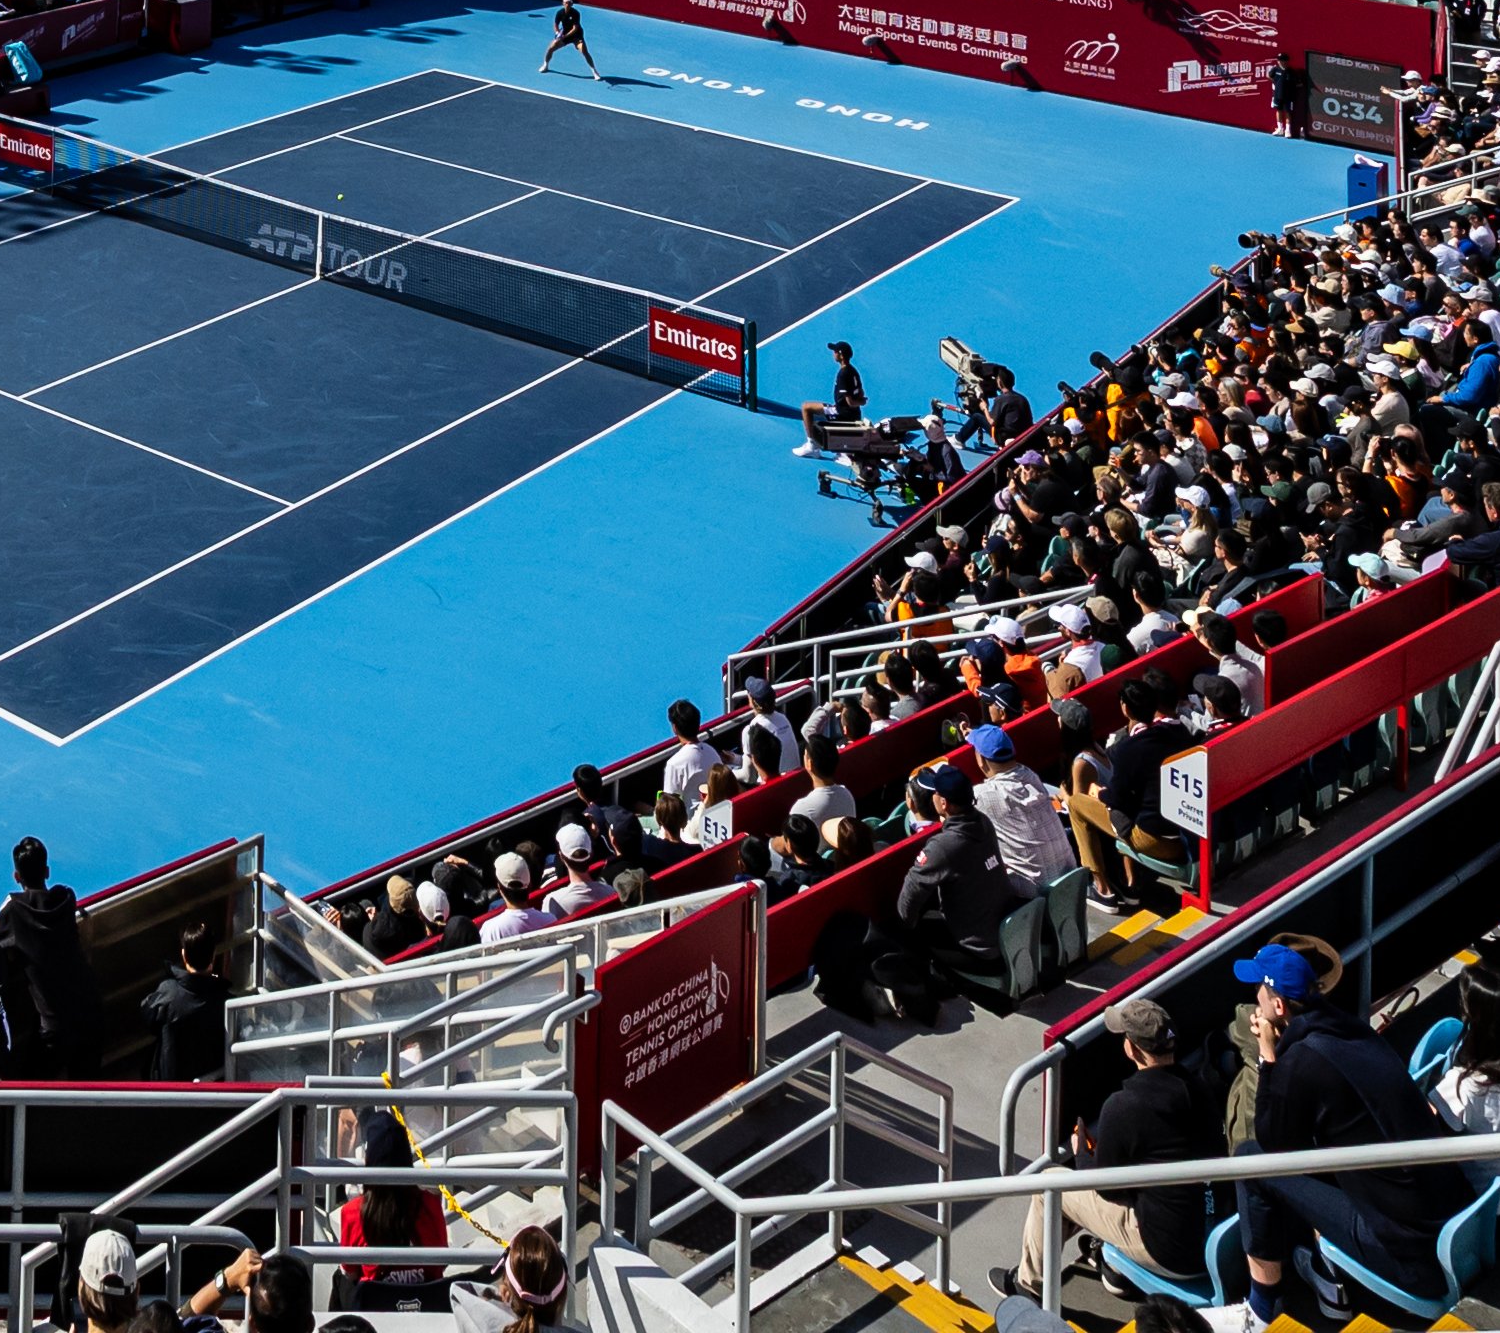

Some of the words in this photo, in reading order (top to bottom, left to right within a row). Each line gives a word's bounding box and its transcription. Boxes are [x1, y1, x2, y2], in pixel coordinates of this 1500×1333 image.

[838, 4, 1028, 51] 大型體育活動事務委員會
[838, 20, 872, 39] Major
[875, 27, 915, 45] Sports
[918, 35, 958, 52] Events
[961, 42, 1029, 64] Committee
[1204, 60, 1253, 79] 政府資助
[1325, 56, 1355, 68] SPEED
[642, 68, 766, 97] KONG
[1324, 87, 1358, 100] MATCH
[1358, 91, 1381, 103] TIME
[796, 98, 930, 131] HONG
[1322, 96, 1384, 125] 0:34
[0, 132, 52, 162] Emirates
[247, 222, 316, 262] ATP
[325, 241, 408, 293] TOUR
[654, 319, 738, 361] Emirates
[1170, 767, 1204, 799] E15
[1178, 808, 1204, 827] Private
[1181, 800, 1204, 818] Carret
[704, 816, 728, 841] E13
[632, 996, 663, 1026] BANK
[662, 989, 677, 1007] OF
[676, 969, 709, 997] CHINA
[647, 1007, 678, 1035] HONG
[679, 985, 709, 1013] KONG
[625, 1029, 666, 1067] TENNIS
[667, 1010, 700, 1039] OPEN
